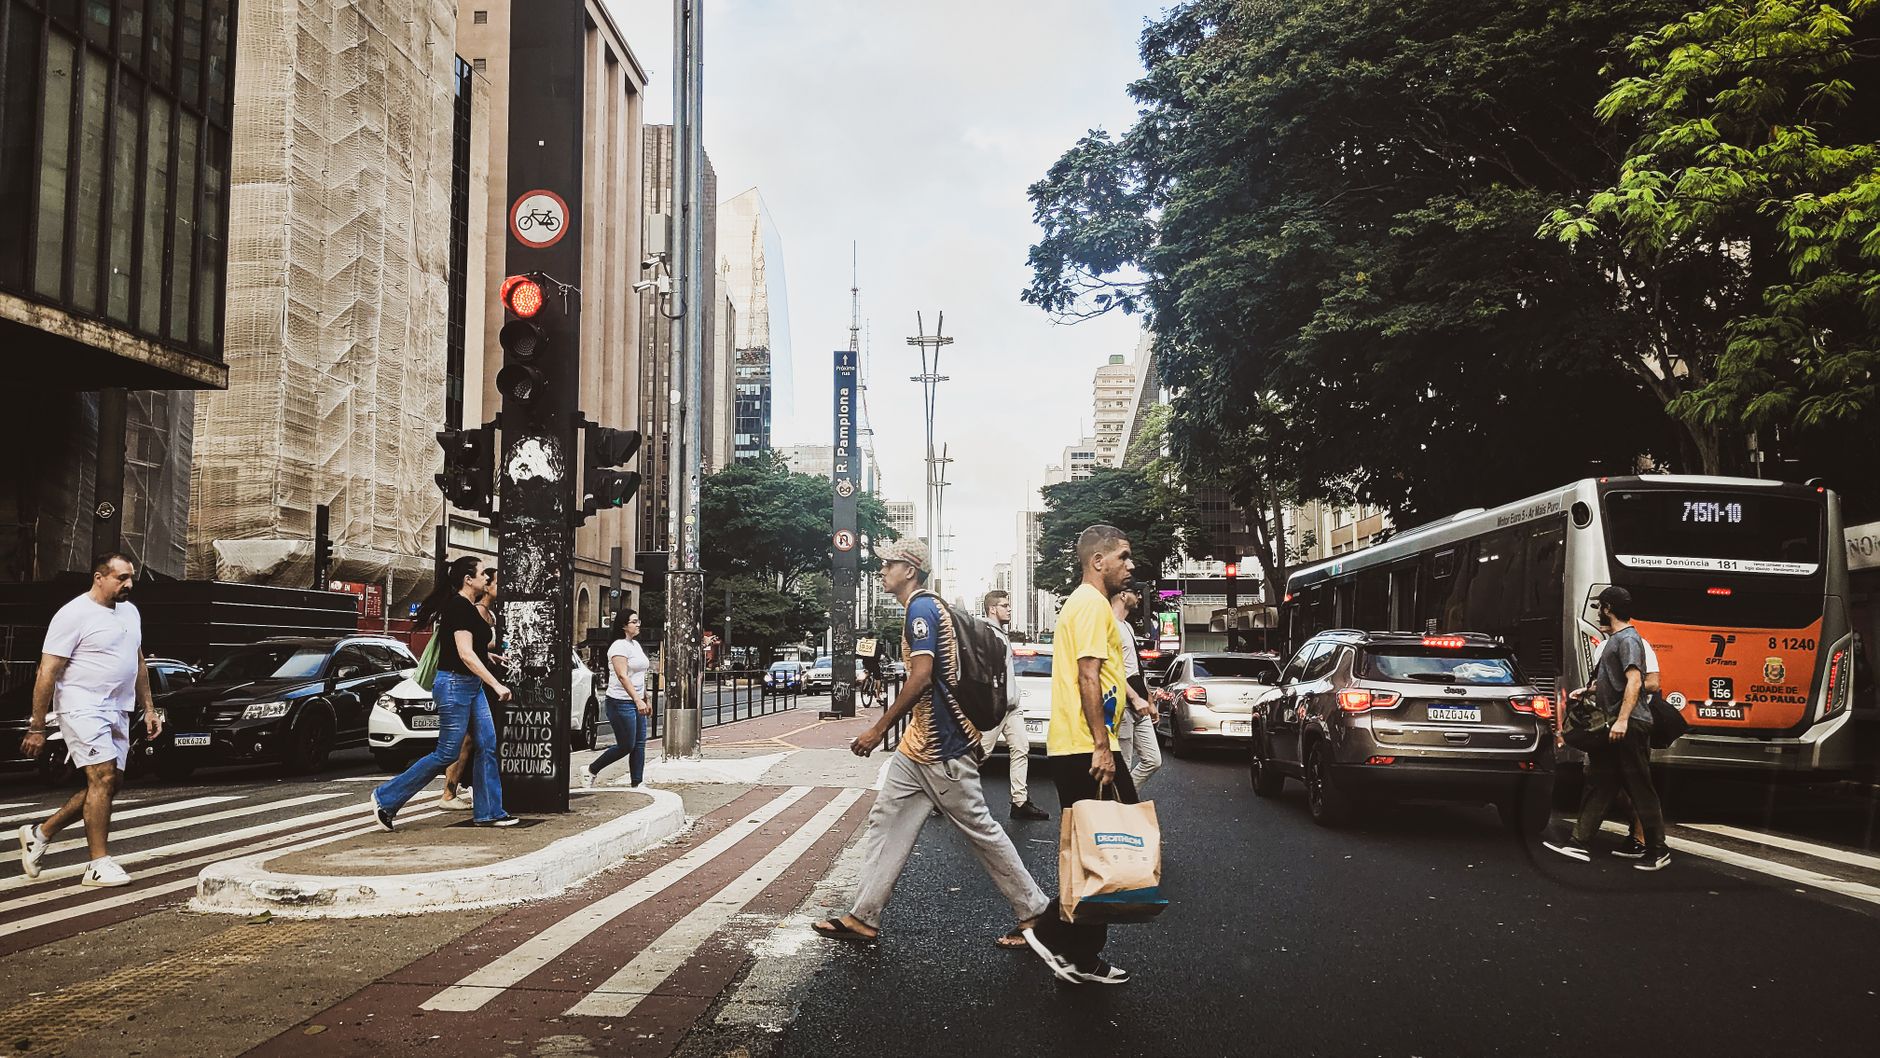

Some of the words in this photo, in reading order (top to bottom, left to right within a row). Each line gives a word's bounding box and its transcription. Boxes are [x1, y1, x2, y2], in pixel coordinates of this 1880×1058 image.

[837, 387, 851, 457] Pamplona
[836, 461, 848, 473] R.
[1682, 502, 1742, 523] 715M-10
[1631, 557, 1662, 566] Disque
[1666, 558, 1710, 567] Denúncia
[1717, 560, 1737, 570] 181
[1768, 637, 1777, 650] 8
[1782, 637, 1815, 651] 1240
[1705, 657, 1737, 666] SPTrans
[1711, 679, 1726, 689] SP
[1750, 685, 1784, 694] CIDADE
[1786, 686, 1798, 694] DE
[1444, 686, 1467, 696] Jeep
[1711, 688, 1731, 699] 156
[1670, 696, 1682, 704] 50
[1745, 692, 1768, 703] SÃO
[1770, 695, 1807, 704] PAULO
[505, 711, 551, 726] TAXAR
[501, 742, 552, 758] GRANDES
[501, 759, 552, 774] FORTUNAS
